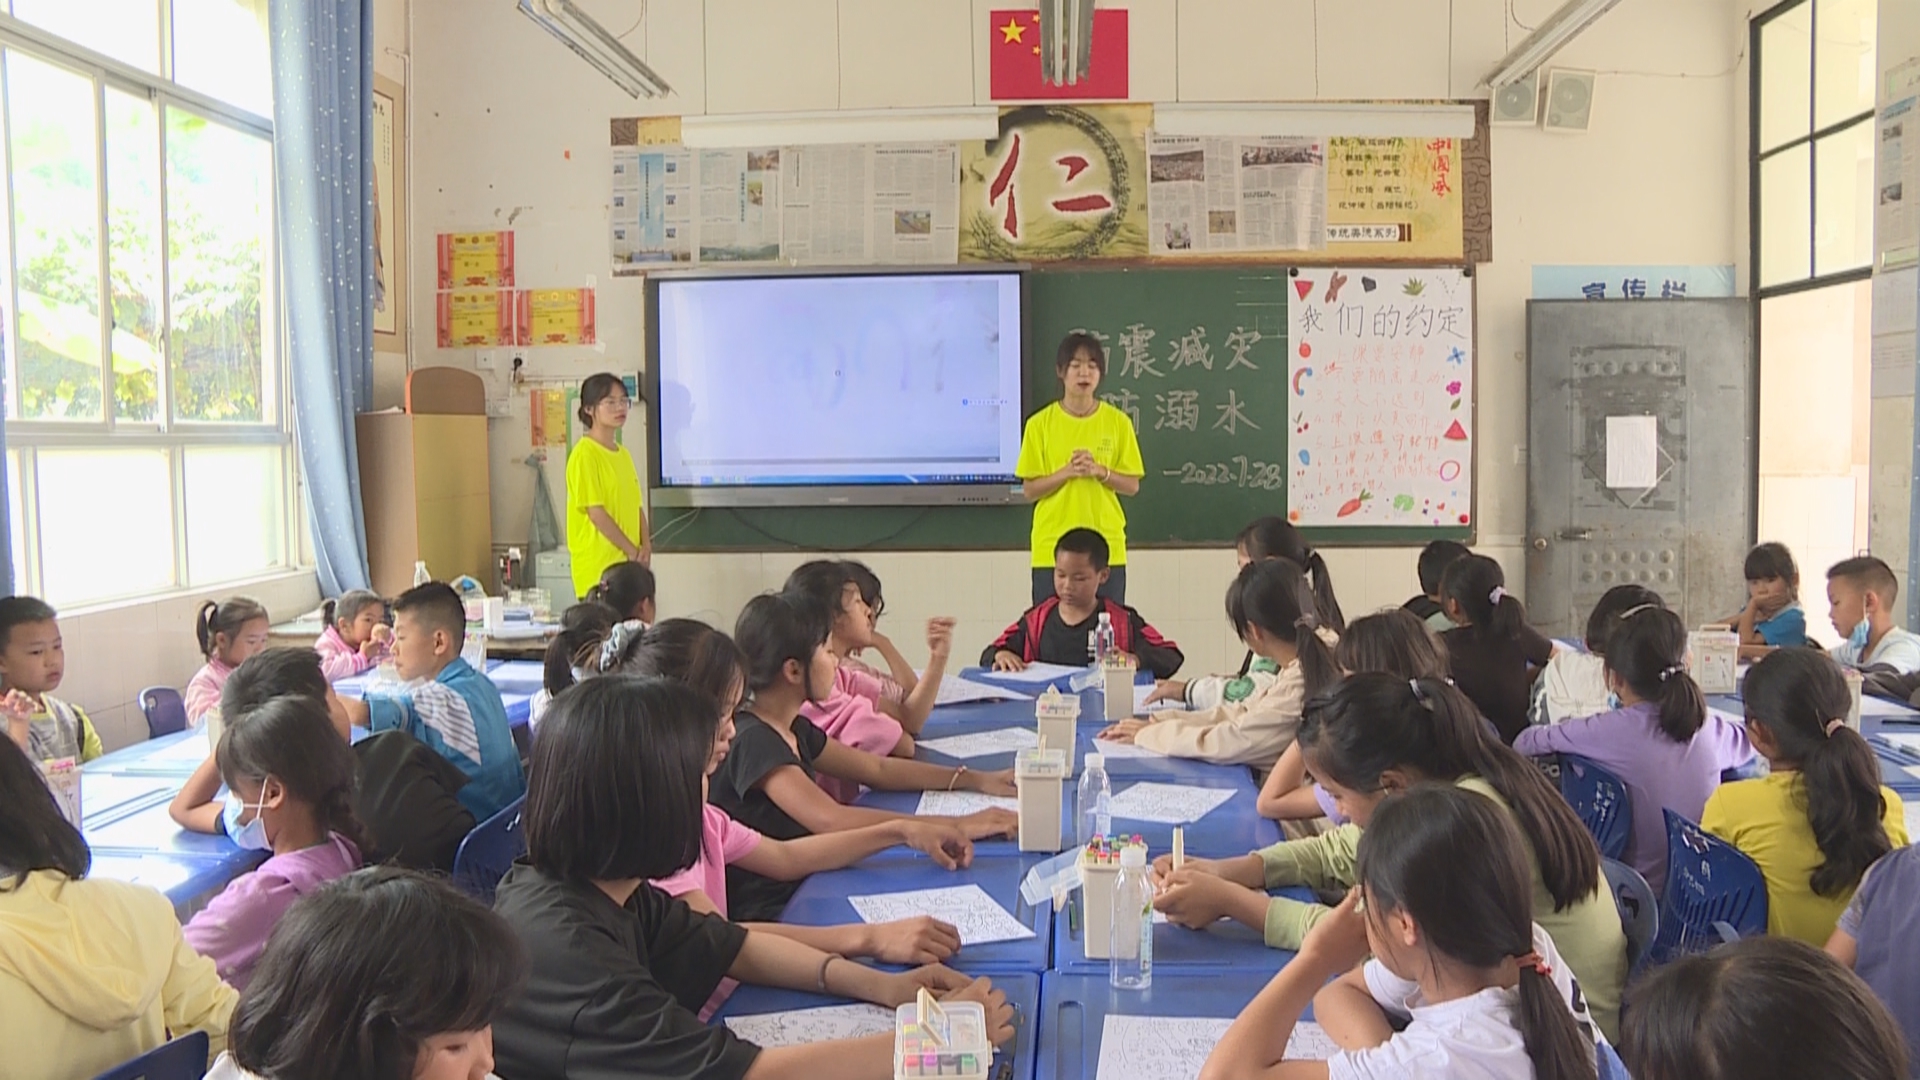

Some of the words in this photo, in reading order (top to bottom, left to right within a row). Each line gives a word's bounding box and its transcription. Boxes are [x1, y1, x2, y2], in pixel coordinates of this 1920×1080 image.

[989, 133, 1112, 239] 仁
[1298, 302, 1469, 340] 我们的约定
